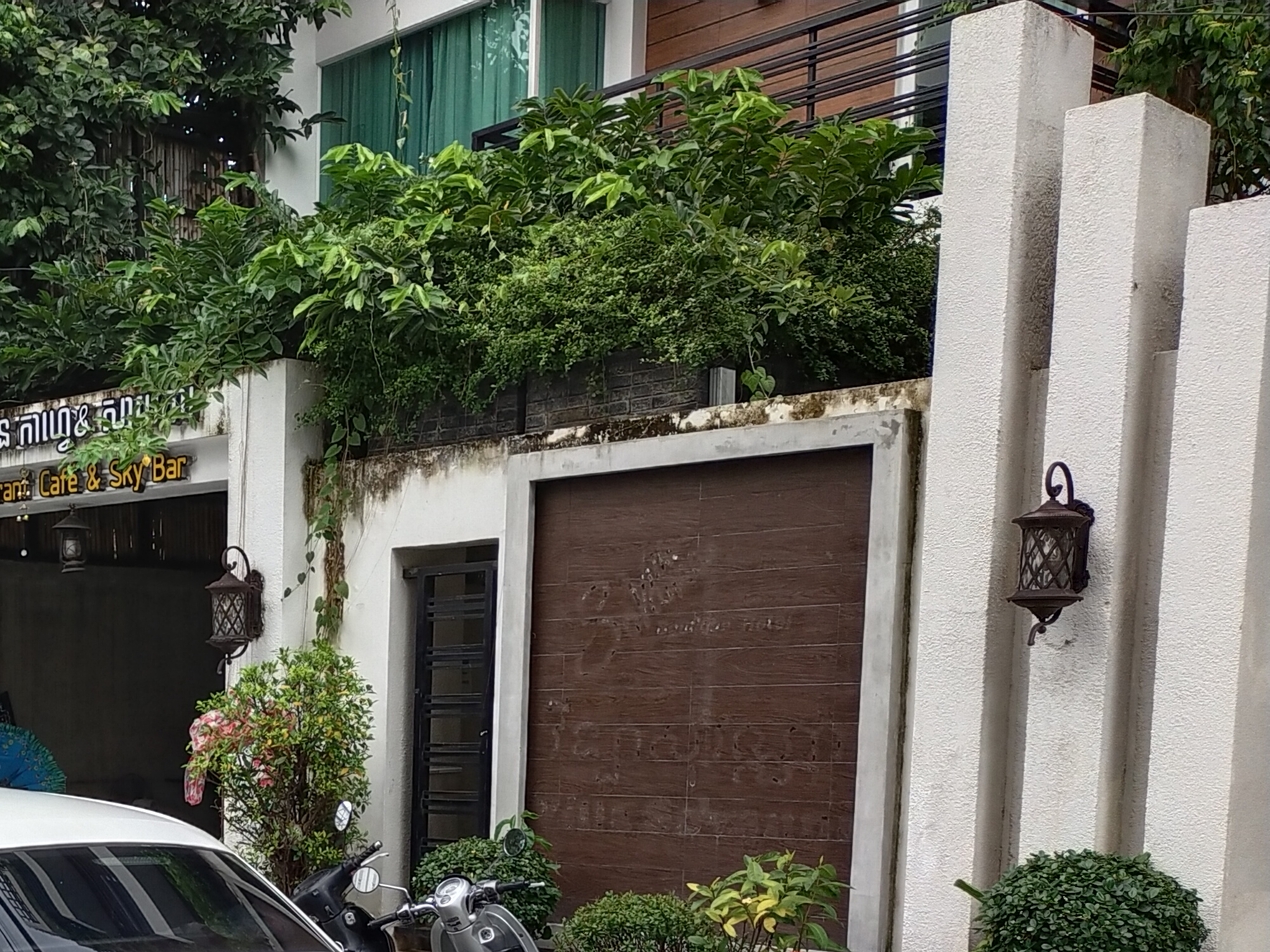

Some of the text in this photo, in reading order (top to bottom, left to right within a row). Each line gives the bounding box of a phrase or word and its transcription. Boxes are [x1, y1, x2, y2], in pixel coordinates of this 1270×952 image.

[87, 463, 101, 491] &
[109, 459, 145, 492] Sky
[153, 454, 187, 482] Bar
